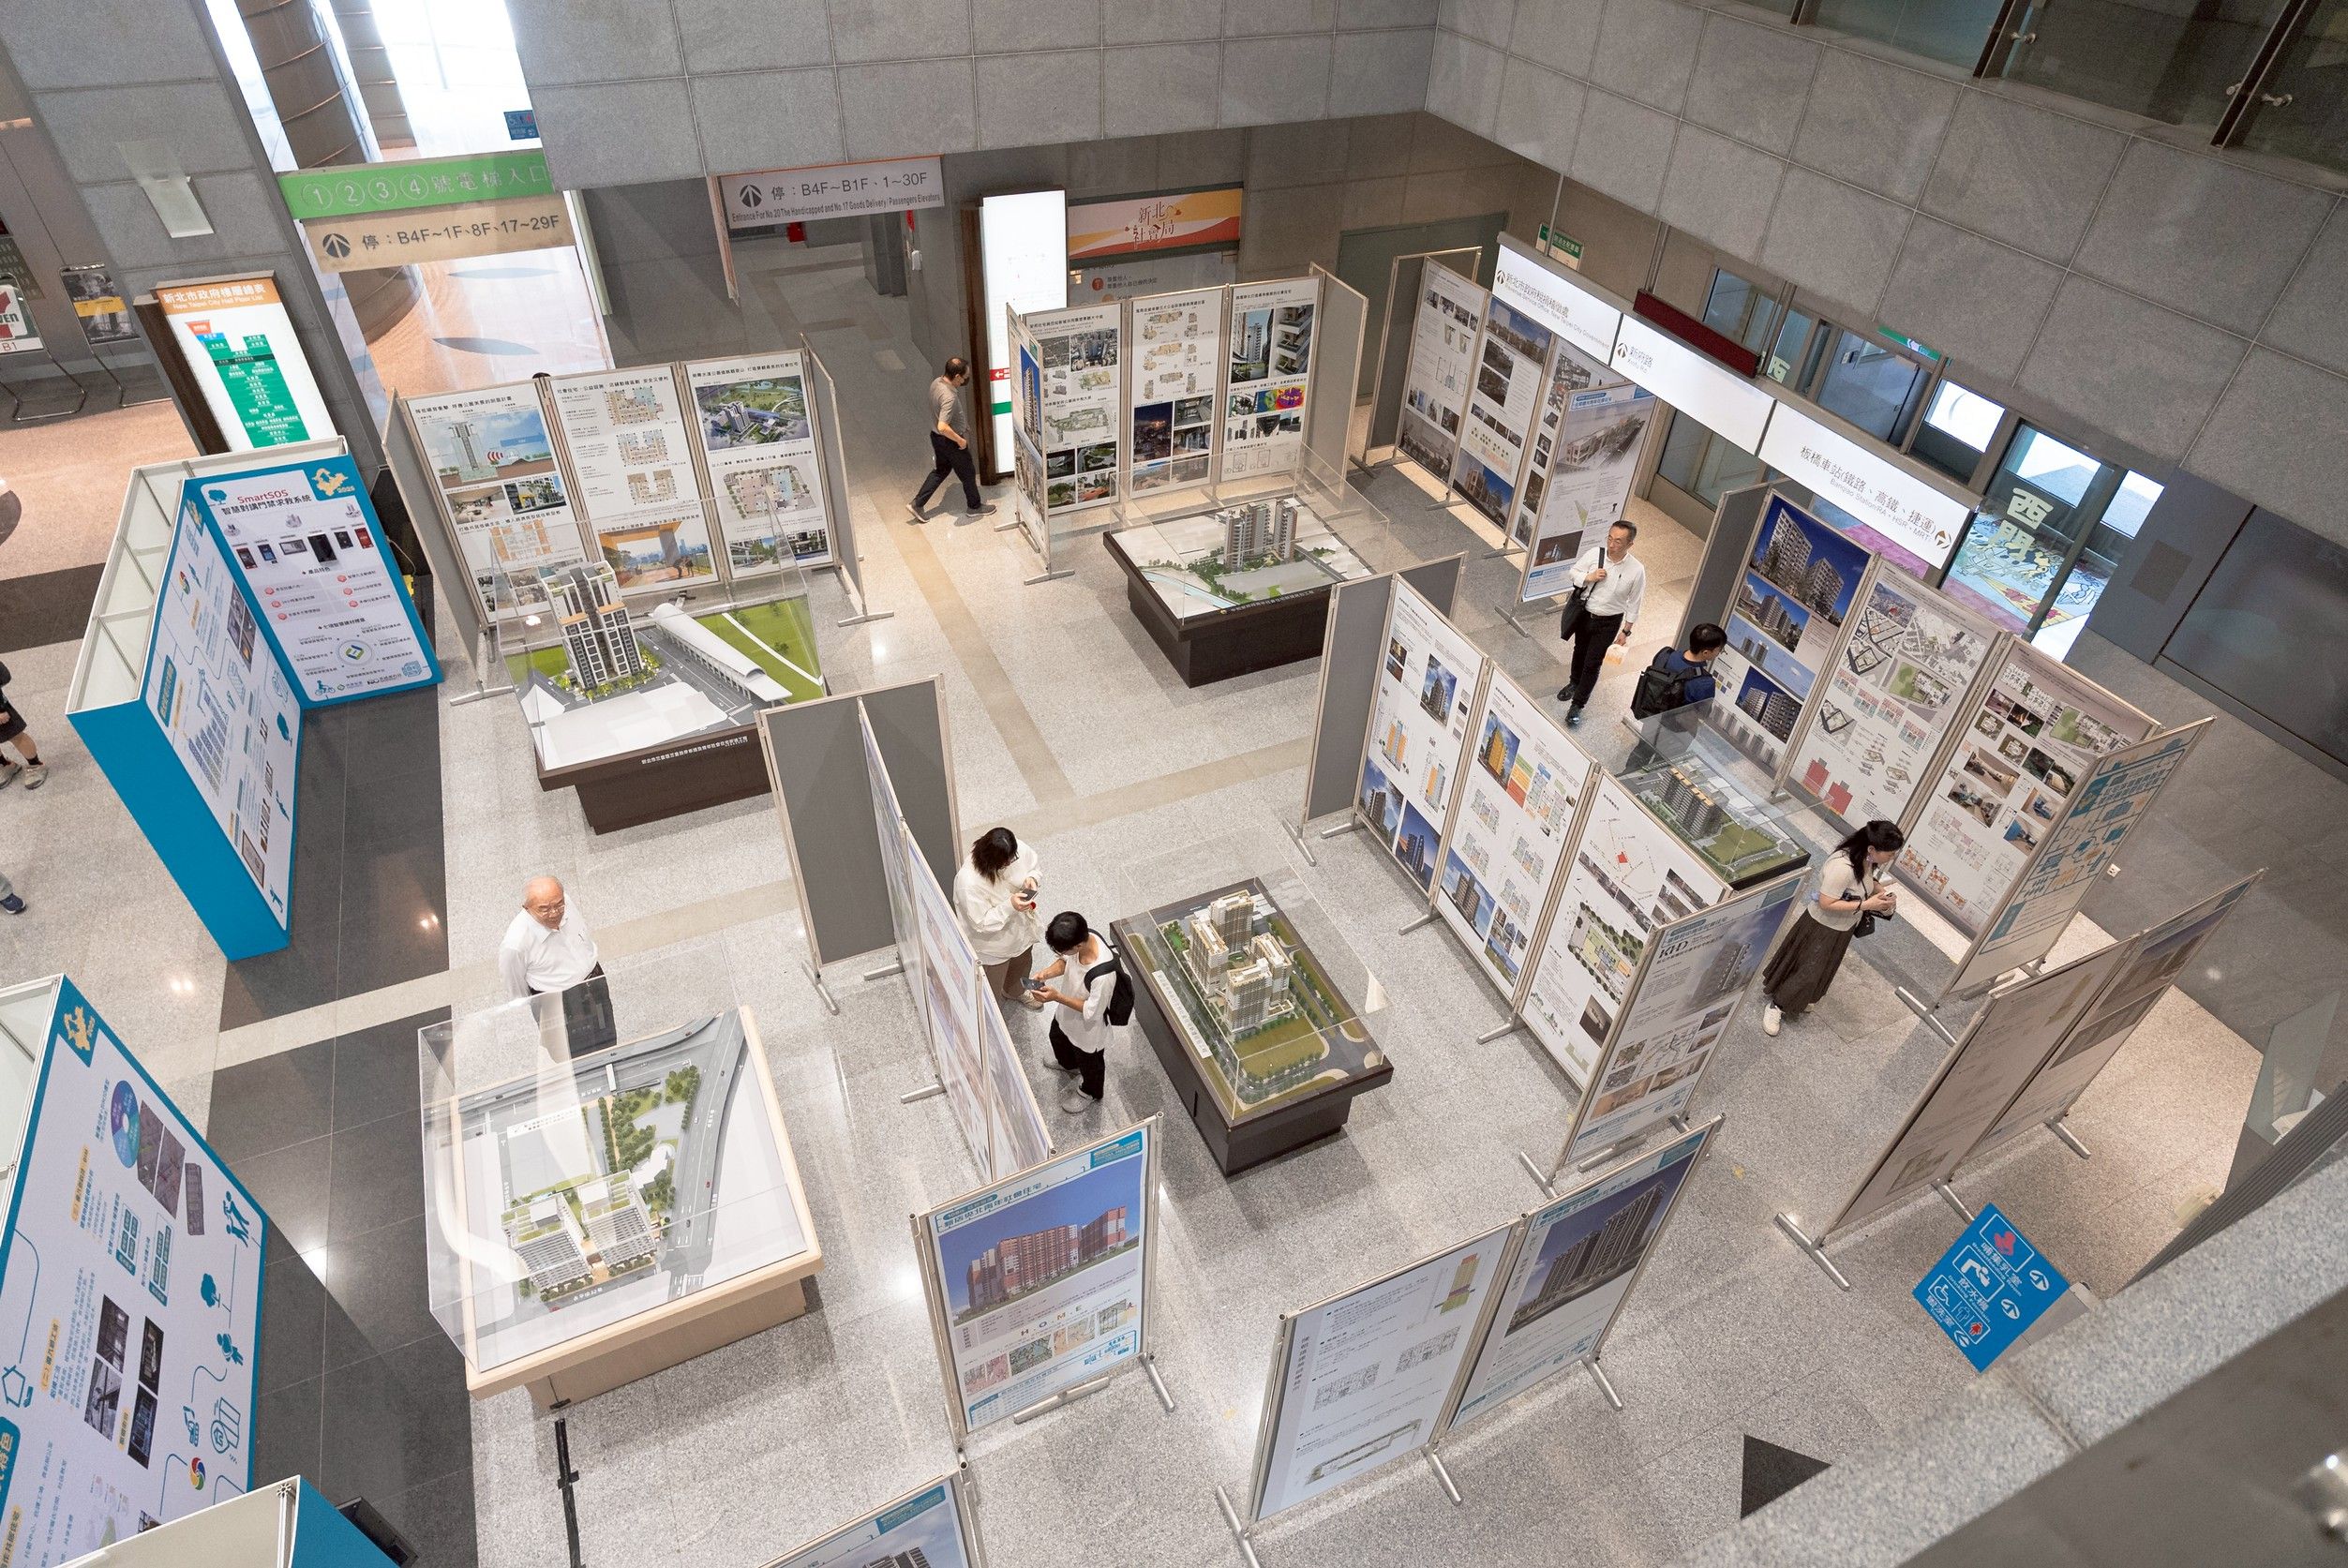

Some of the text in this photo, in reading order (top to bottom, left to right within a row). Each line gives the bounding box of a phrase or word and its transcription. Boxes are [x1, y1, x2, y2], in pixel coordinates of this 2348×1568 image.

[732, 210, 755, 222] Entrance
[755, 209, 766, 219] For
[781, 207, 791, 217] The
[791, 202, 825, 217] Handicapped
[849, 200, 865, 210] Goods
[2, 342, 18, 351] B1
[221, 494, 312, 515] 智慧對講門禁求救系統
[237, 488, 290, 505] SmartSOS
[1958, 1277, 1990, 1312] 飲水機
